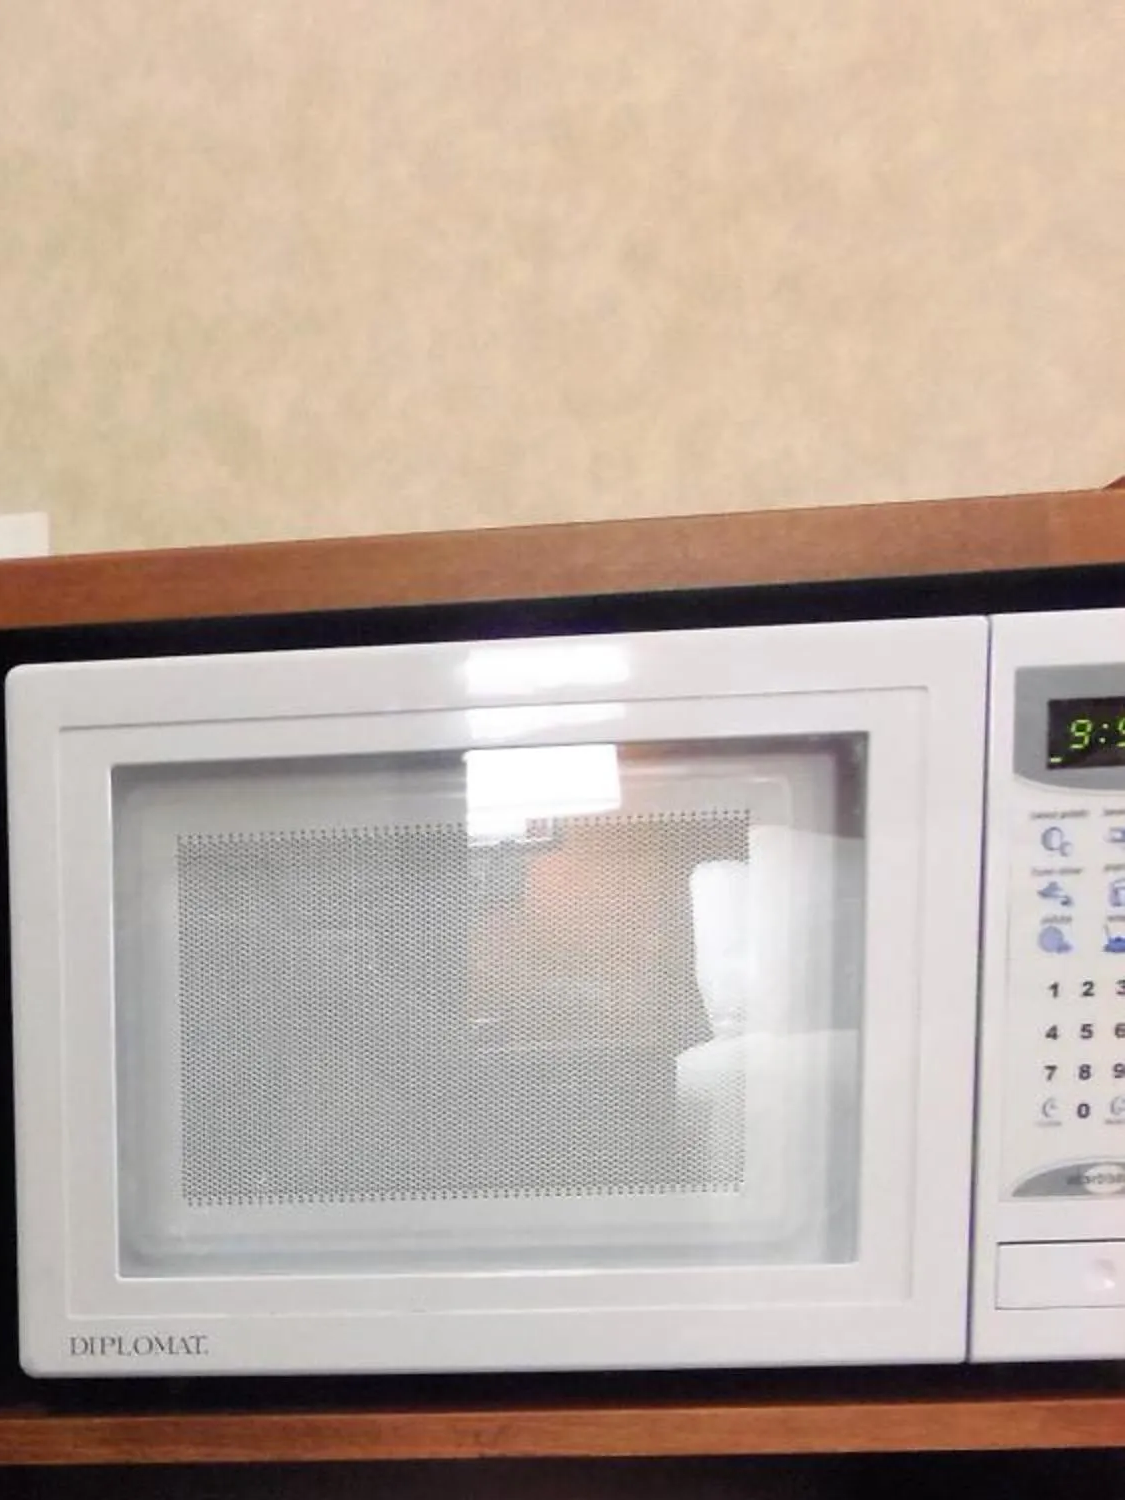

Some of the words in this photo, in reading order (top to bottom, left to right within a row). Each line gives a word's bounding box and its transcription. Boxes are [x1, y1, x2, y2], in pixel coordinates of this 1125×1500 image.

[1047, 981, 1060, 999] 1
[1081, 980, 1095, 998] 2
[1044, 1024, 1059, 1041] 4
[1080, 1023, 1093, 1040] 5
[1114, 1022, 1125, 1039] 6
[1044, 1064, 1058, 1081] 7
[1078, 1063, 1092, 1081] 8
[1112, 1062, 1125, 1080] 9
[1076, 1102, 1091, 1119] 0
[69, 1335, 209, 1357] DIPLOMAT
